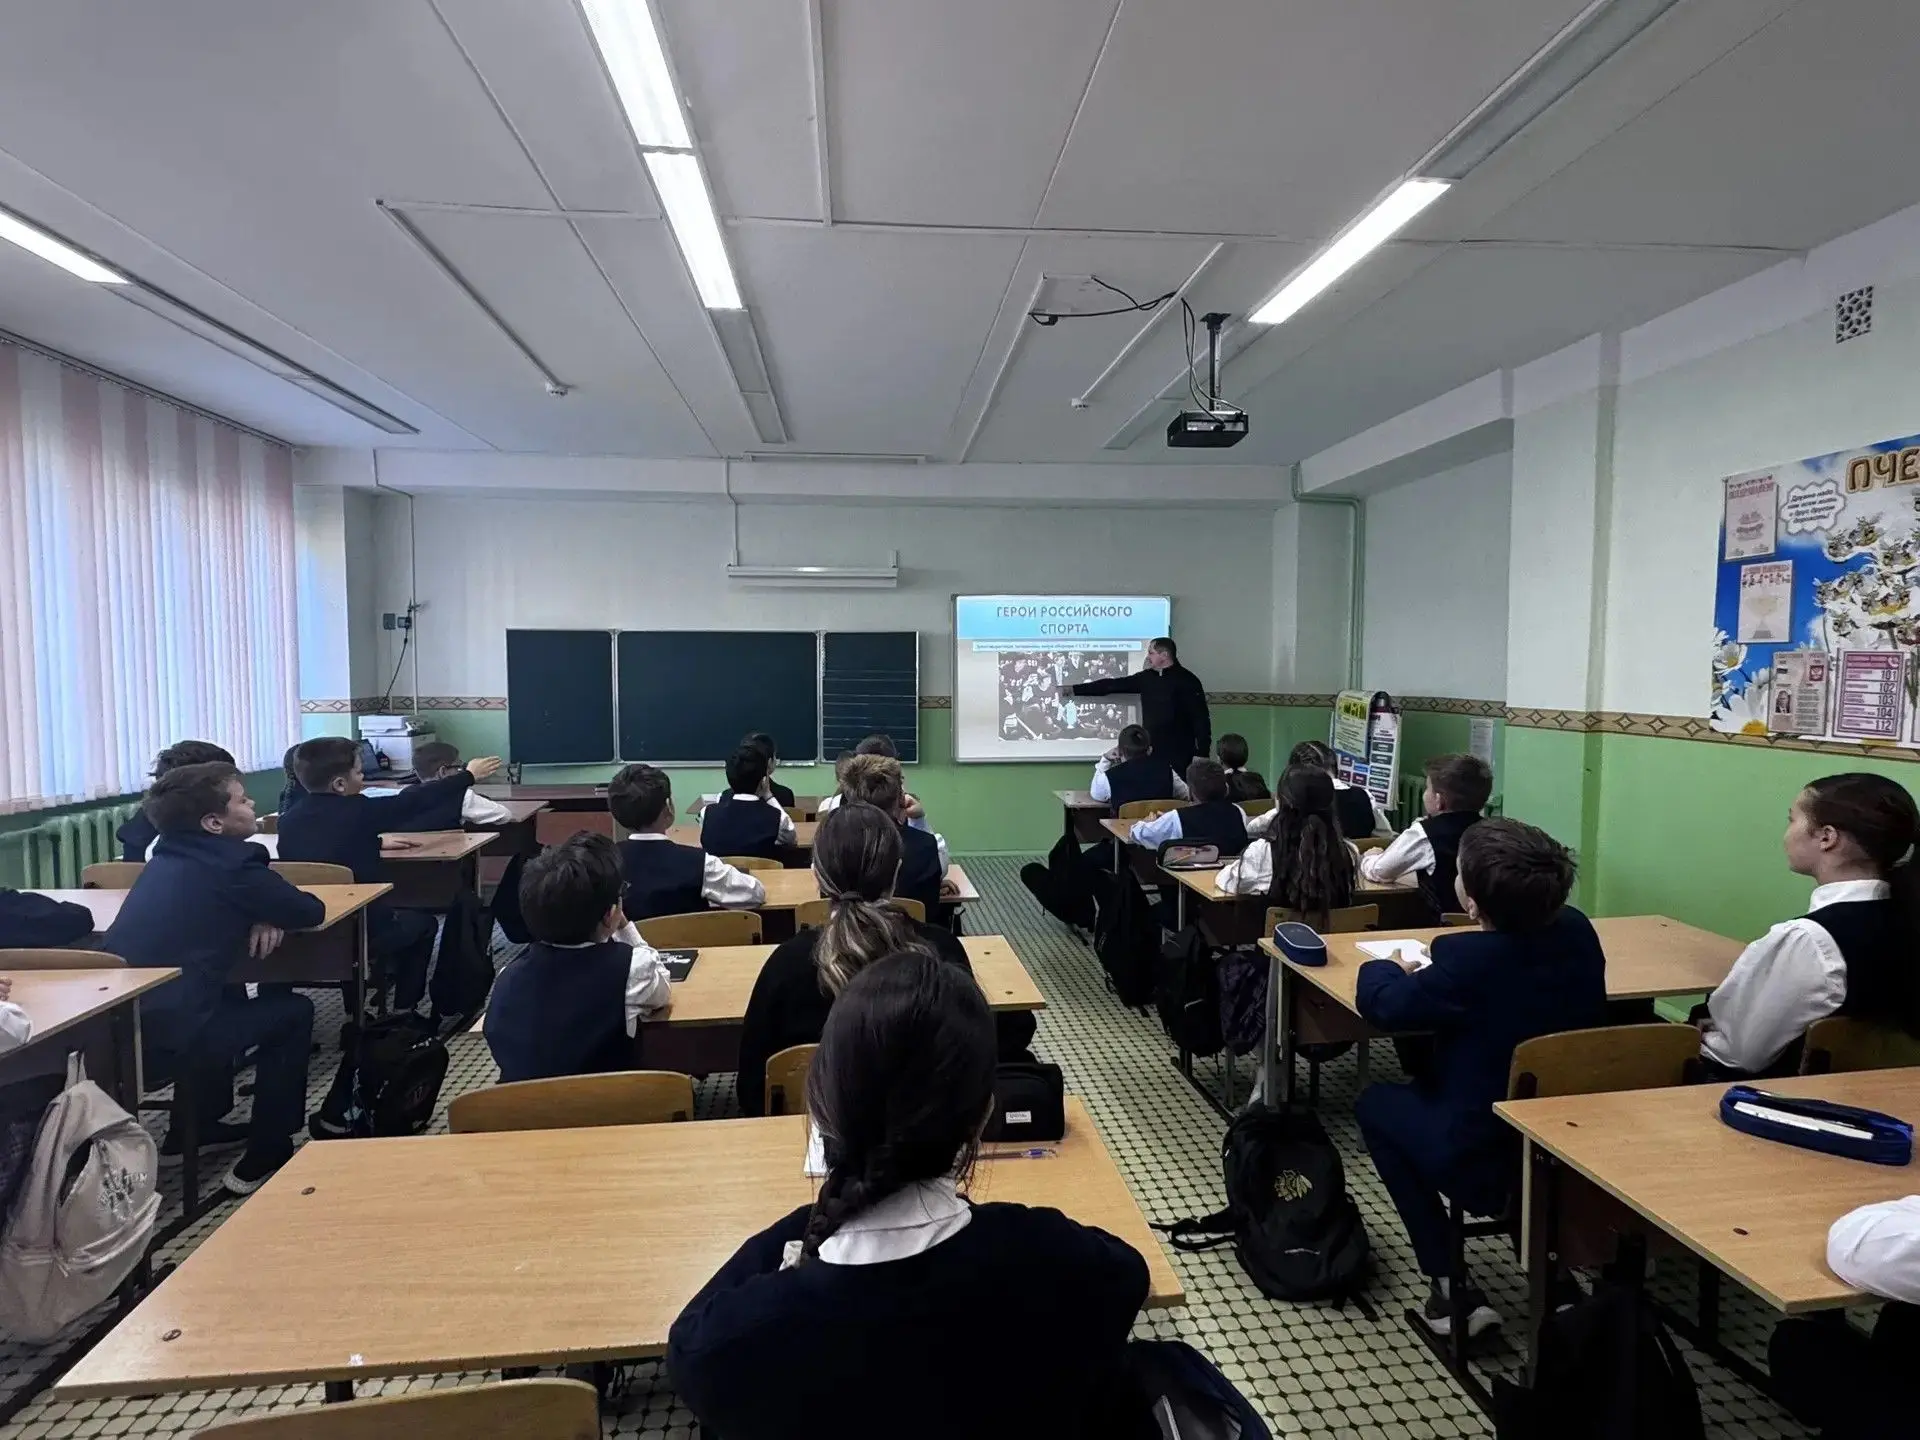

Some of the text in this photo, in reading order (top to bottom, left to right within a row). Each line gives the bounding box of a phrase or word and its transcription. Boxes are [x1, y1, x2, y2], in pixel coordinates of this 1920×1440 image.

[997, 604, 1133, 617] ГЕРОИ РОССИЙСКОГО
[1040, 623, 1089, 634] СПОРТА
[1881, 670, 1897, 680] 101
[1880, 682, 1895, 693] 102
[1878, 695, 1893, 705] 103
[1877, 707, 1892, 717] 104
[1876, 720, 1891, 730] 112
